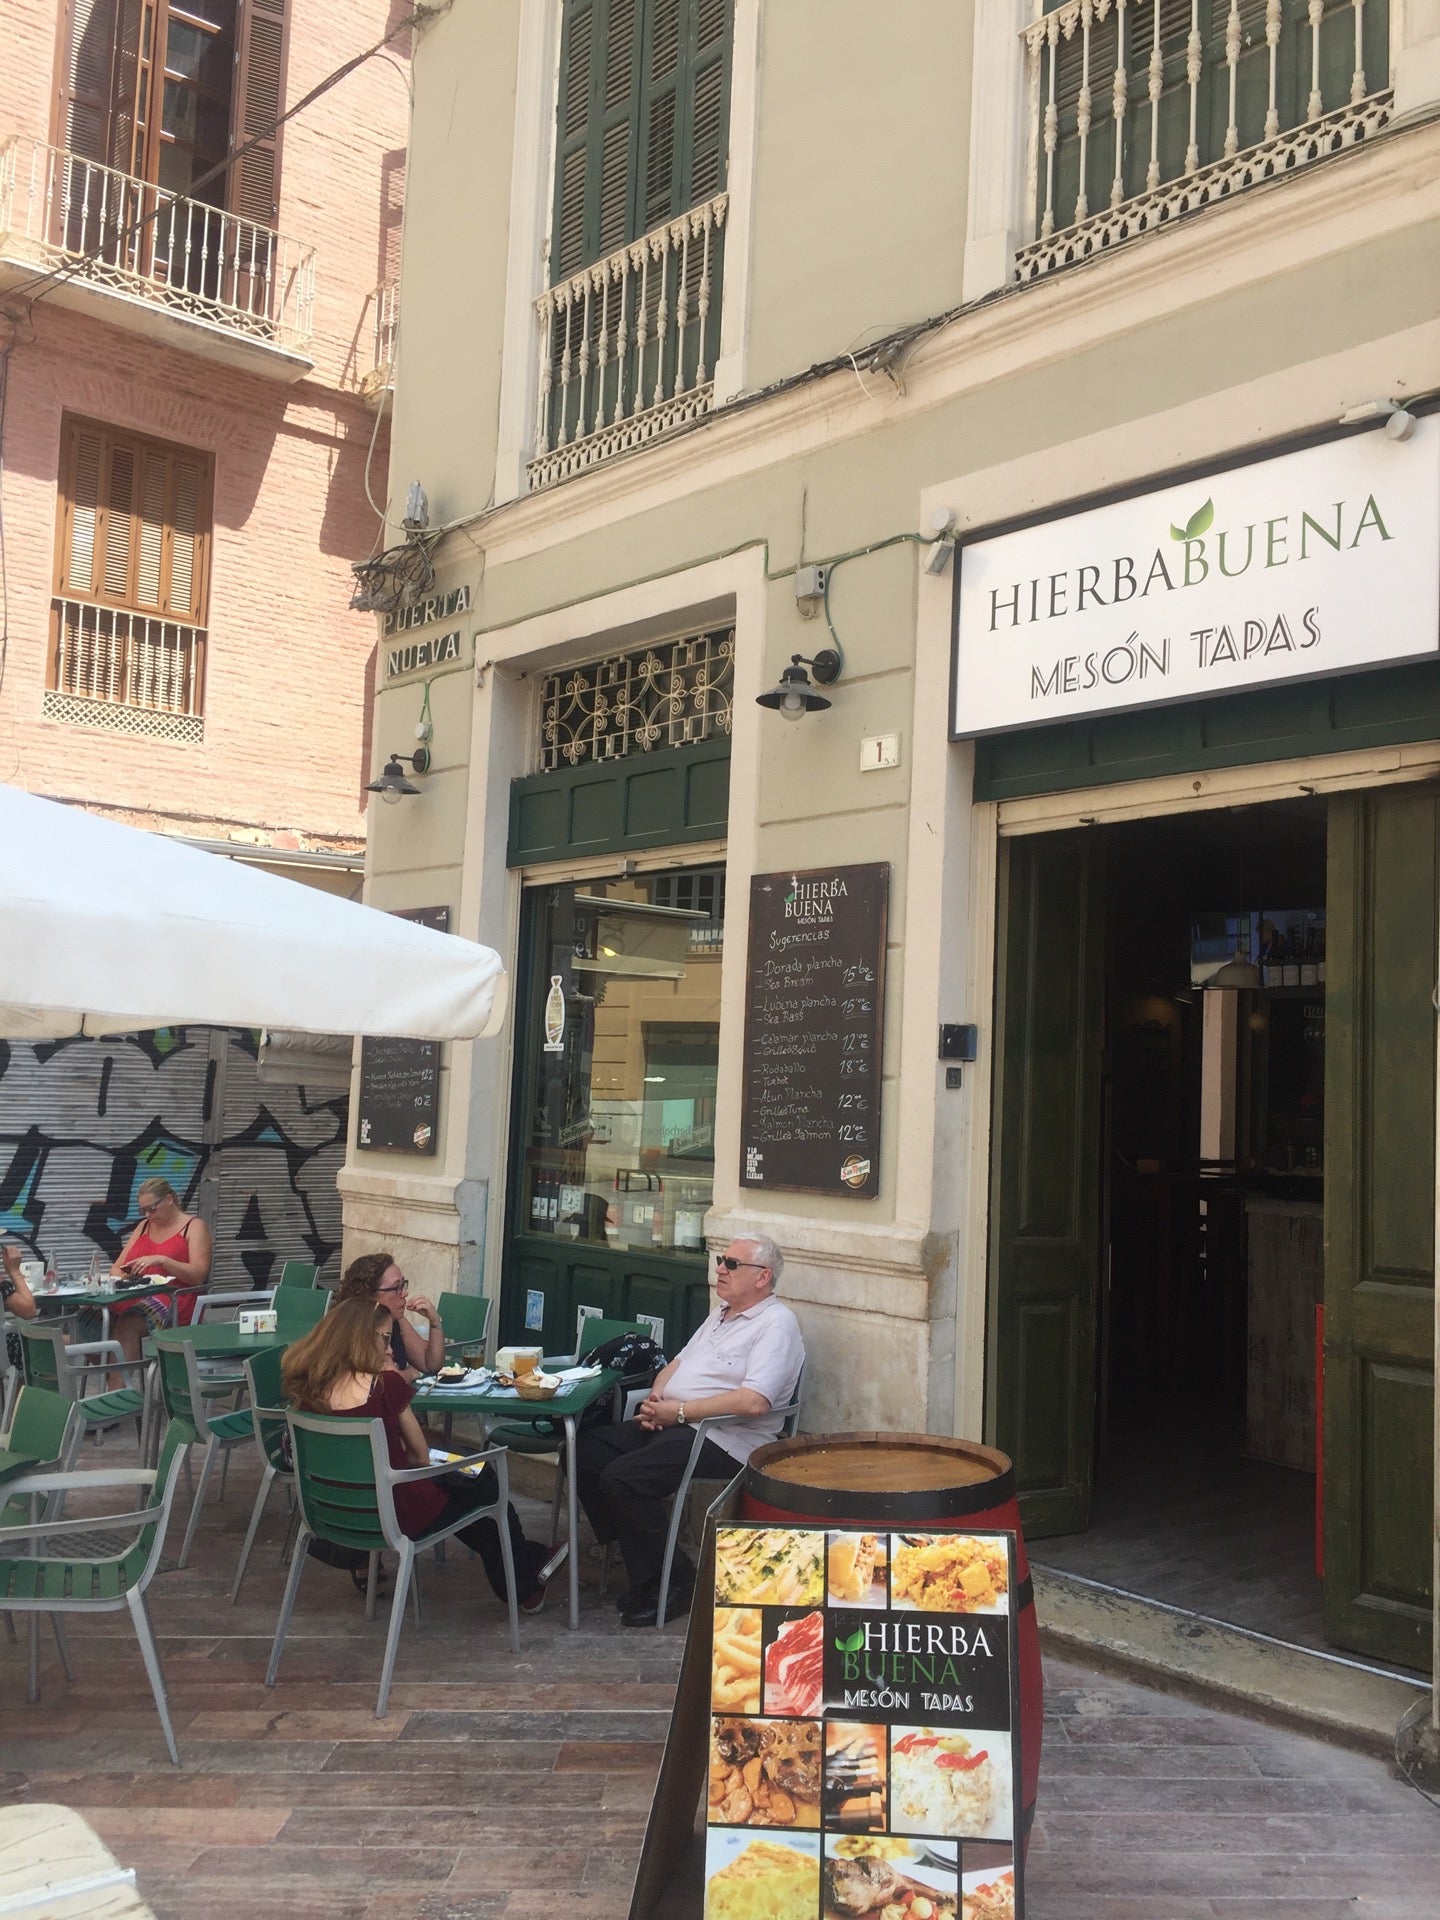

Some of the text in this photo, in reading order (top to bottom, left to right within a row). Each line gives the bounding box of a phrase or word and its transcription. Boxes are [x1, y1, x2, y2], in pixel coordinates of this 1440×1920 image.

[387, 633, 460, 676] NUEVA
[1031, 607, 1322, 699] MESÓN TAPAS
[876, 741, 882, 763] 1
[794, 881, 848, 900] HIERBA
[785, 900, 833, 918] BUENA
[769, 930, 831, 952] Sugerencias
[764, 957, 802, 976] Dorada
[862, 1622, 994, 1657] HIERBA
[843, 1652, 962, 1686] BUENA
[844, 1687, 974, 1713] MESÓN TAPAS
